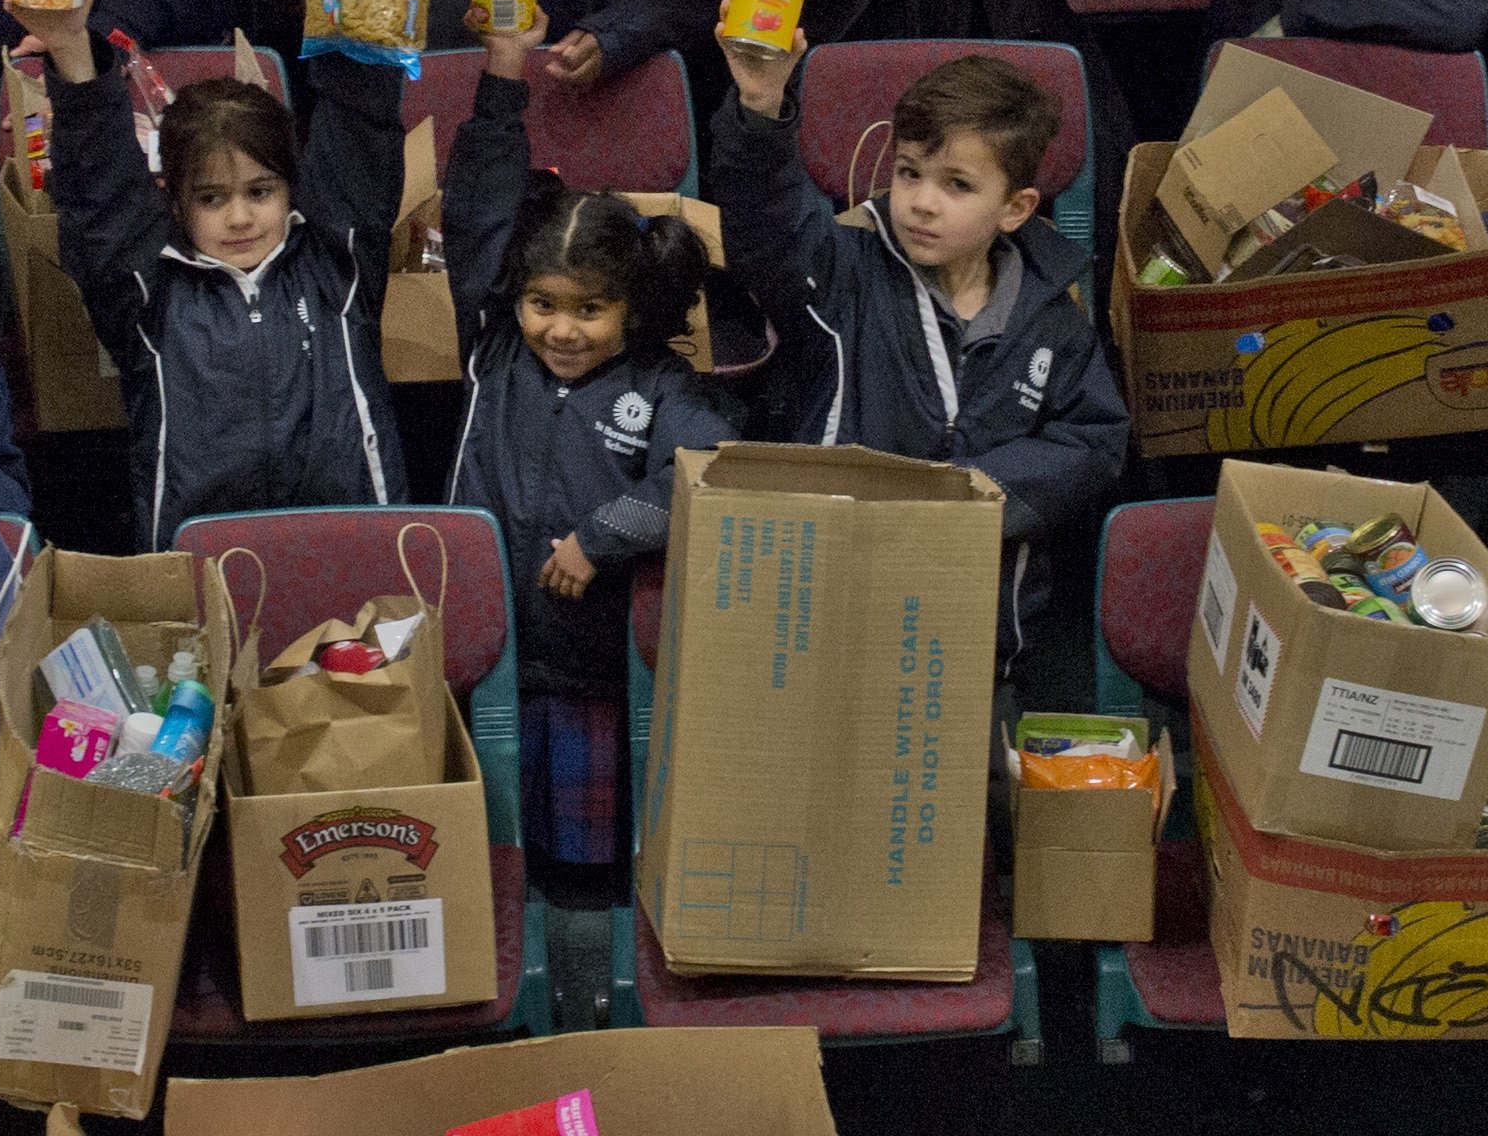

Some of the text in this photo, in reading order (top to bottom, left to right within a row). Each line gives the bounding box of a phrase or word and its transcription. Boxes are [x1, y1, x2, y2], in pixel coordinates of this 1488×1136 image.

[1145, 368, 1245, 390] BANANAS
[1146, 390, 1245, 413] PREMIUM
[715, 516, 735, 610] NEW ZEALAND
[737, 517, 755, 603] LOWER HUTT
[774, 549, 794, 609] EASTERN
[794, 520, 816, 653] MEXICAN SUPPLIES
[772, 612, 790, 649] HUTT
[771, 652, 789, 689] ROAD
[1330, 687, 1379, 707] TTIA/NZ
[886, 593, 921, 886] HANDLE WITH CARE
[917, 637, 945, 845] DO NOT DROP
[295, 817, 422, 854] Emerson's
[387, 903, 412, 913] PACK
[33, 943, 144, 973] 53x16x27.5cm
[1249, 927, 1369, 965] BANANAS
[1248, 954, 1367, 990] PREMIUM
